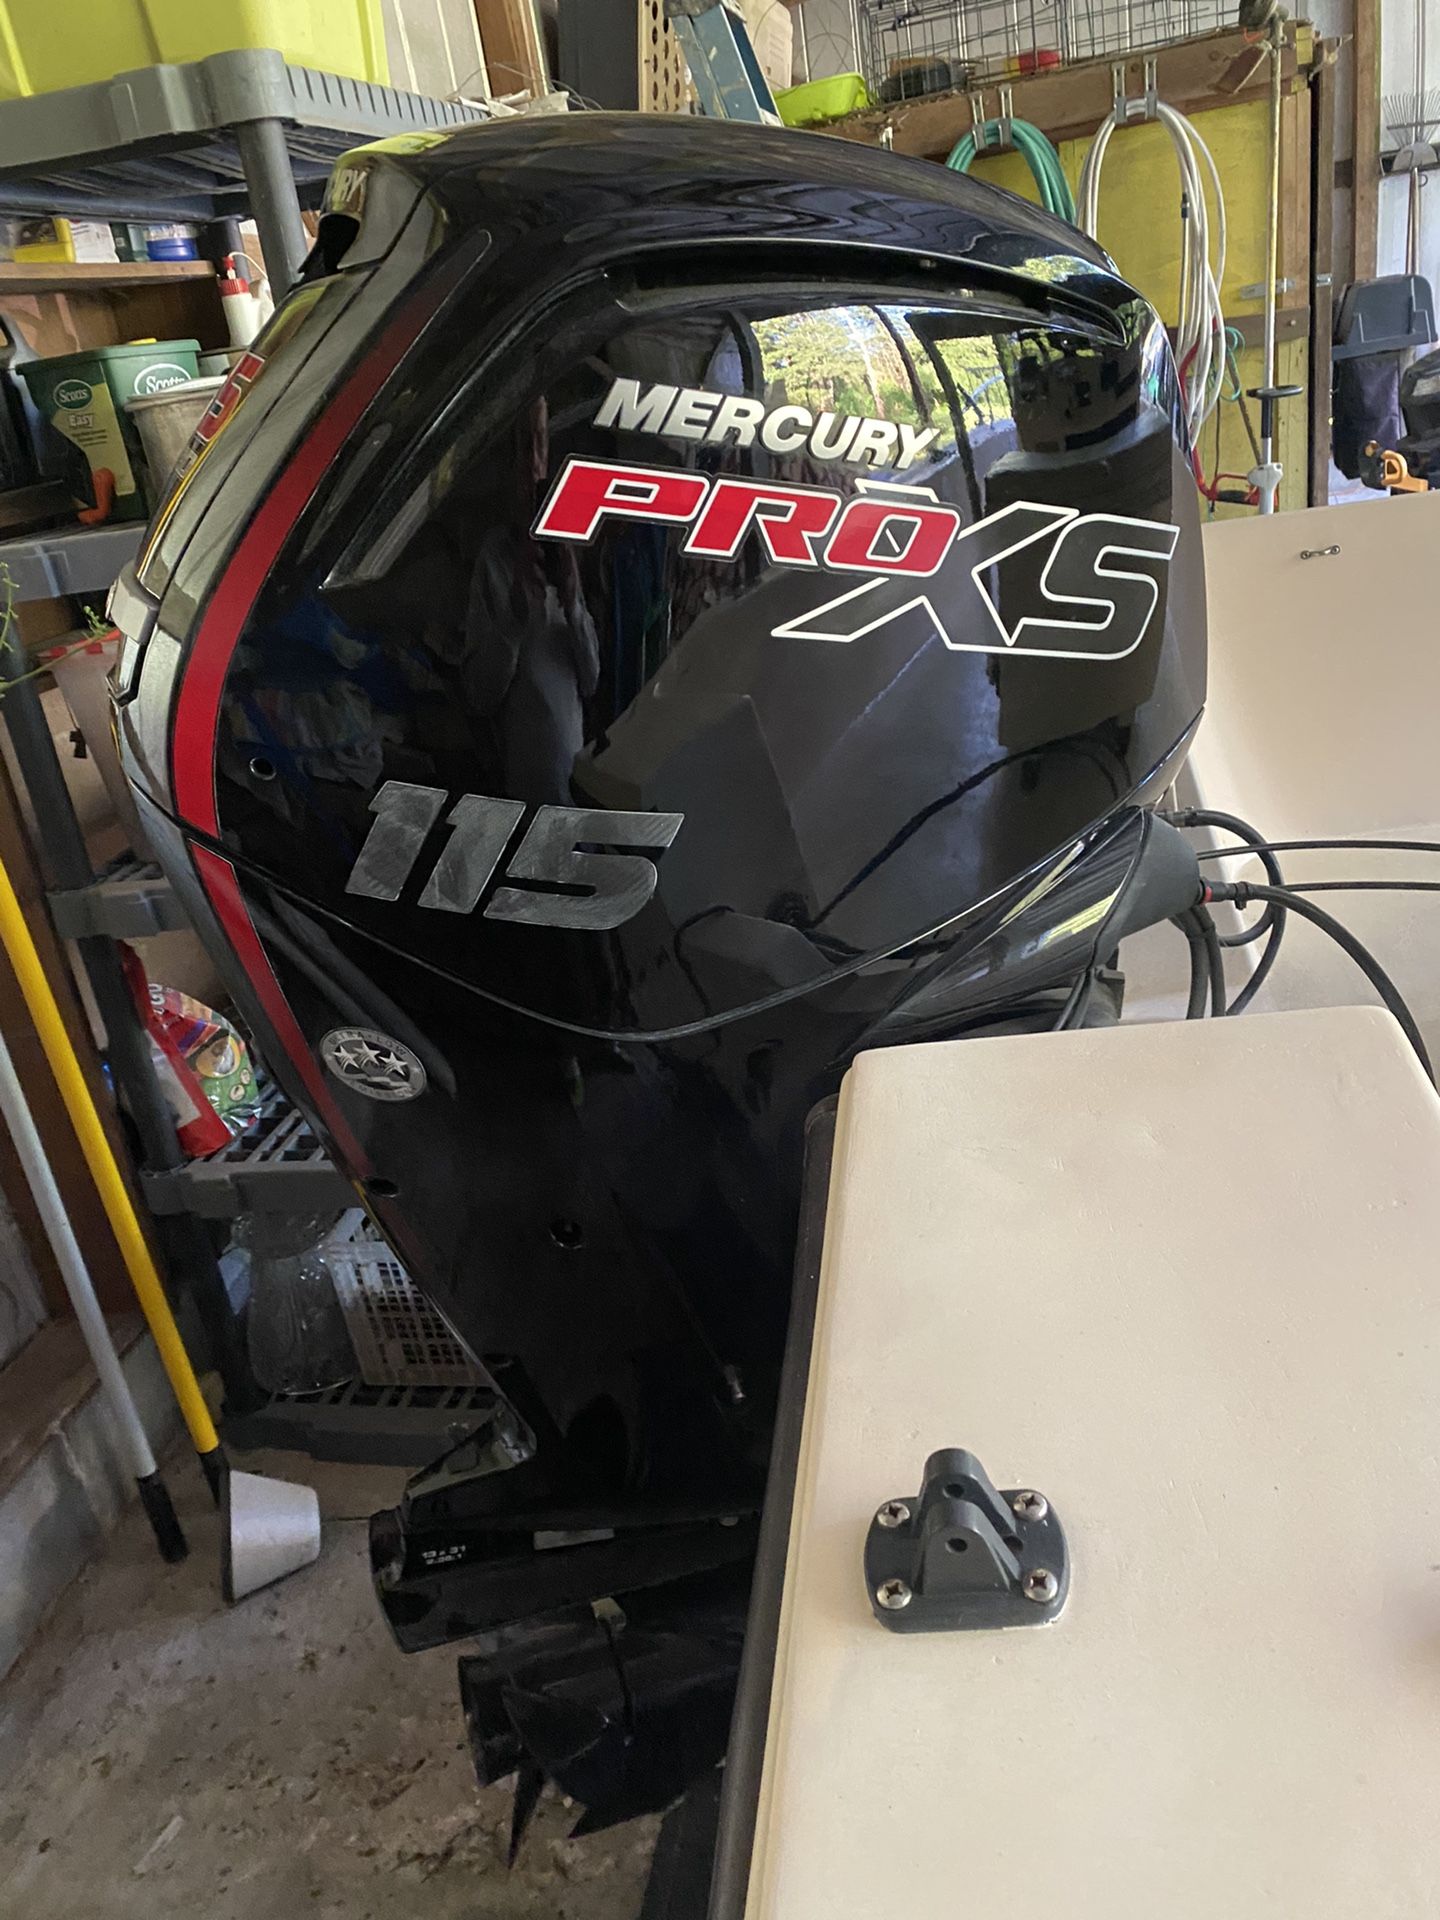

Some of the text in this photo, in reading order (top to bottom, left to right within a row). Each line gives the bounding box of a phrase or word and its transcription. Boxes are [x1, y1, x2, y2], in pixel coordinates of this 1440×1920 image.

[59, 387, 89, 403] Scotts
[594, 377, 940, 469] MERCURY
[532, 456, 1180, 660] PRO XS
[344, 780, 686, 930] 115
